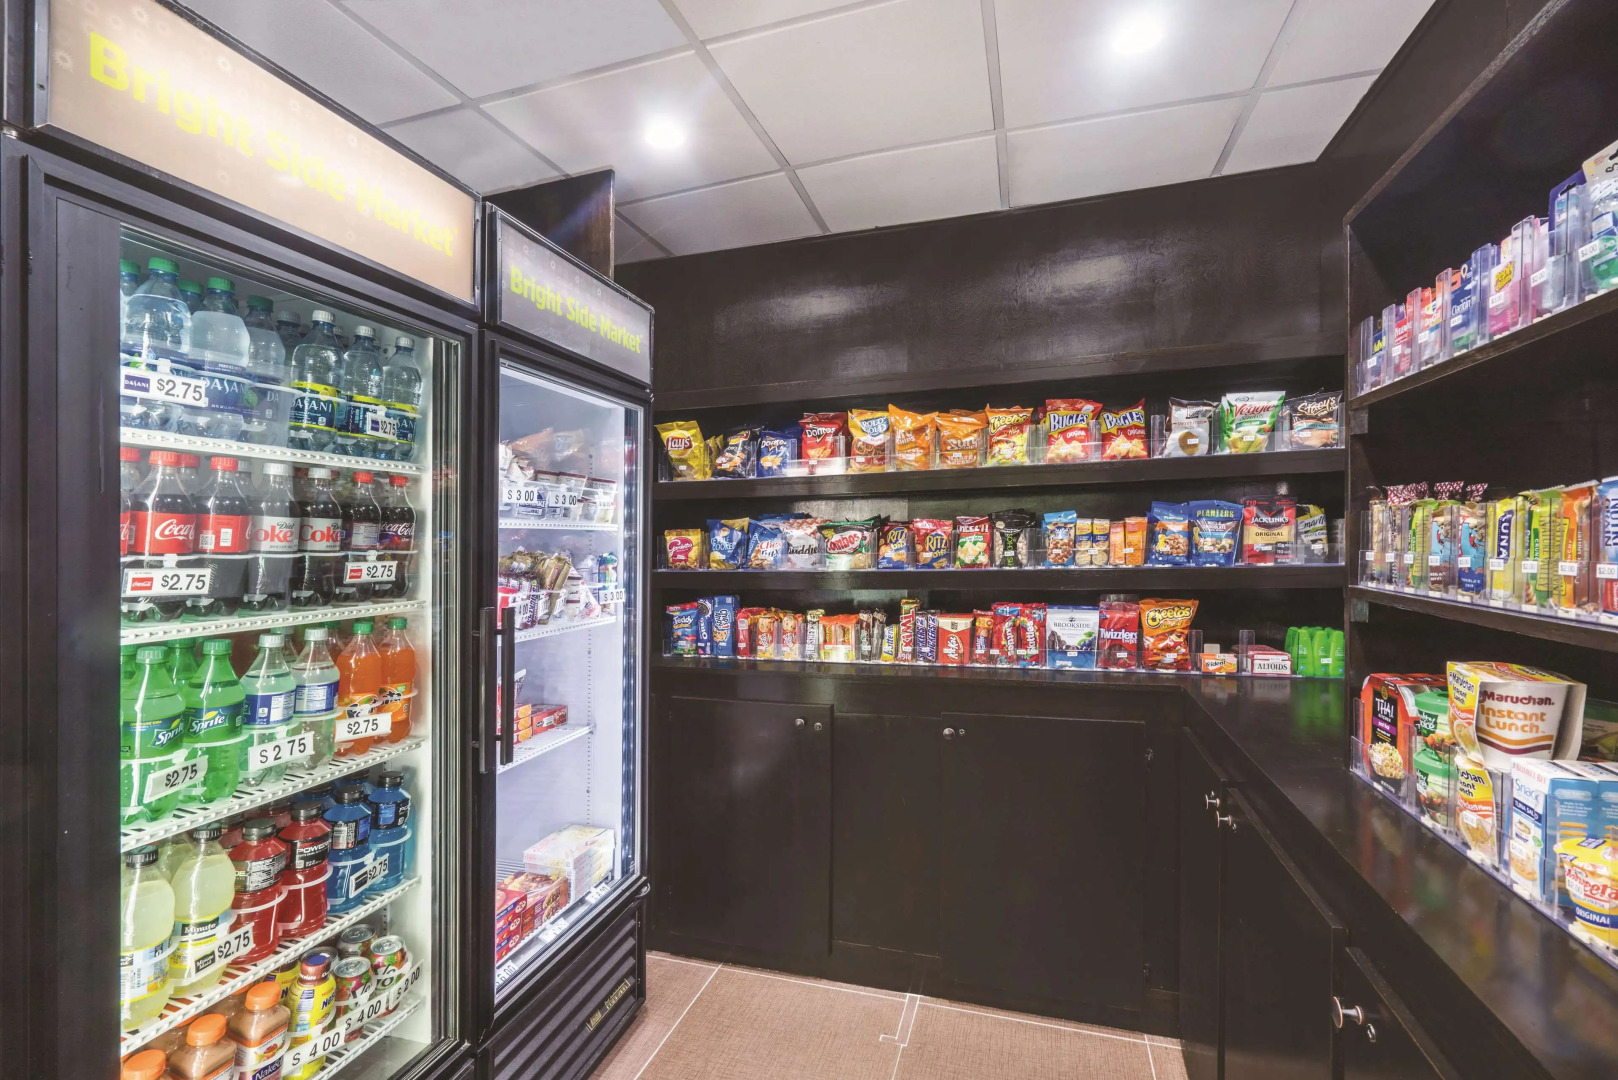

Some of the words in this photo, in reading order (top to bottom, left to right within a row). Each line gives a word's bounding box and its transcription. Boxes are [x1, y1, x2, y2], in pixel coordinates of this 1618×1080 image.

[89, 31, 255, 157] Bright
[265, 128, 348, 203] Side
[356, 176, 455, 257] Market
[510, 265, 563, 316] Bright
[565, 296, 597, 332] Side
[600, 315, 641, 354] Market
[156, 378, 203, 402] $2.75
[1234, 401, 1276, 418] Veggie
[1297, 396, 1336, 416] Stacy's
[380, 419, 396, 436] $2.75
[989, 414, 1031, 435] Cheetos
[1049, 412, 1090, 432] BUGLES
[805, 426, 836, 439] Doritos
[1196, 509, 1234, 518] PLANTERS
[254, 525, 294, 543] oke
[276, 521, 296, 530] Diet
[1499, 512, 1513, 559] LUNA
[926, 535, 947, 550] RITZ
[1005, 533, 1013, 566] PISCHIOS
[366, 564, 394, 579] $2.75
[1598, 566, 1616, 576] $2.00
[160, 573, 206, 592] $2.75
[673, 615, 693, 623] Teddy
[1145, 605, 1192, 628] Cheetos
[700, 617, 708, 640] OREO
[901, 609, 915, 648] TWIX
[1005, 620, 1016, 657] Skittles
[1026, 620, 1038, 655] Skittles
[1100, 627, 1138, 640] Twizzlers
[926, 624, 938, 661] SNICKERS
[1256, 662, 1288, 672] ALTOIDS
[1375, 697, 1395, 719] THAI
[1480, 703, 1547, 722] Instant
[189, 713, 226, 733] Sprite
[347, 718, 379, 735] $2.75
[1485, 718, 1540, 734] Lunch
[273, 744, 282, 761] 2
[287, 737, 307, 757] 75
[164, 763, 198, 789] $2.75
[1514, 800, 1527, 812] TUNA
[368, 858, 388, 881] $2.75
[184, 922, 218, 935] Minute
[217, 930, 251, 960] $2.75
[366, 999, 382, 1018] 00
[308, 1043, 318, 1058] 4
[321, 1031, 341, 1052] 00
